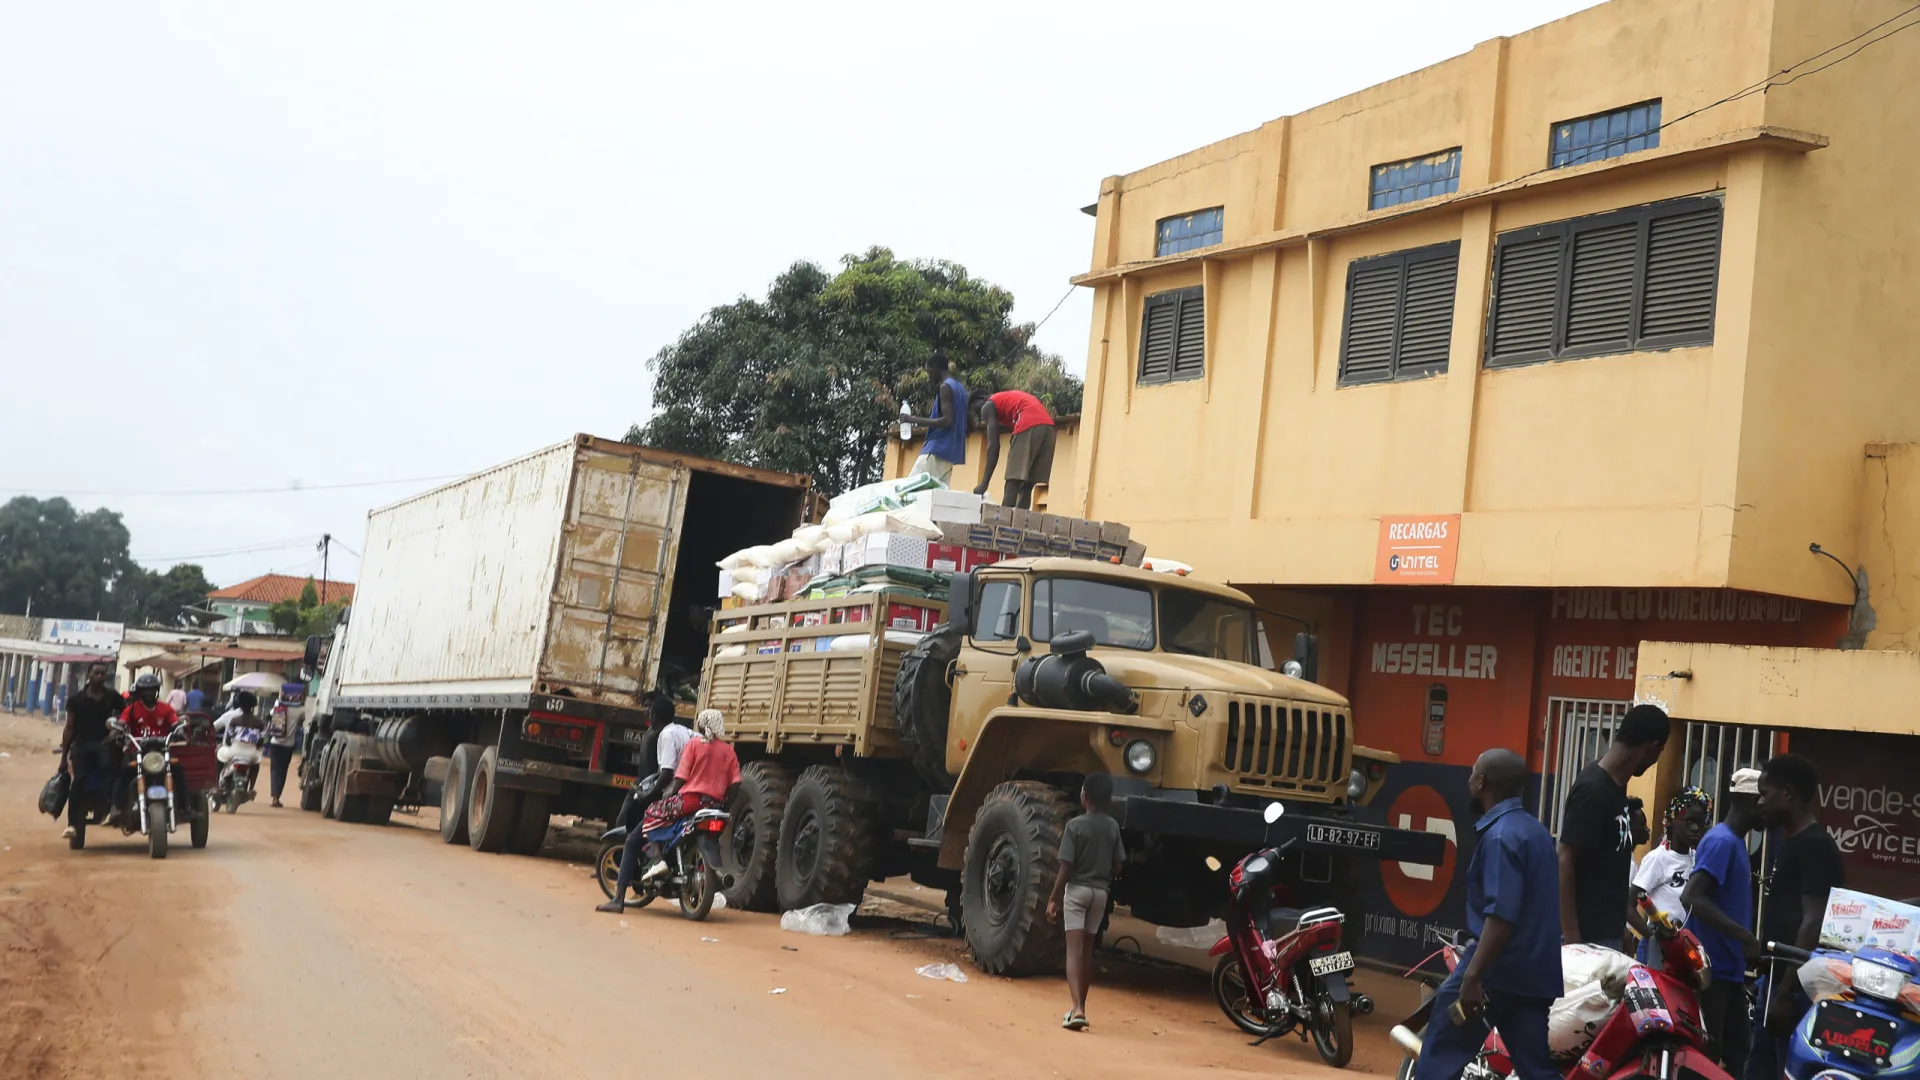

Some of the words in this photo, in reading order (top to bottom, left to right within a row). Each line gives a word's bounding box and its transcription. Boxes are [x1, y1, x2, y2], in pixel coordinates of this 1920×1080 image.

[1389, 522, 1448, 540] RECARGAS
[1401, 556, 1439, 569] UNITEL
[1551, 587, 1649, 620] FIDALGO
[1413, 604, 1462, 636] TEC
[1371, 643, 1498, 680] MSSELLER
[1553, 645, 1609, 678] AGENTE
[1615, 647, 1635, 680] DE
[1310, 825, 1377, 847] LD-82-97-EF
[1832, 900, 1866, 916] Madar
[1364, 912, 1396, 937] próximo
[1400, 919, 1418, 939] mais
[1872, 914, 1910, 931] Madar
